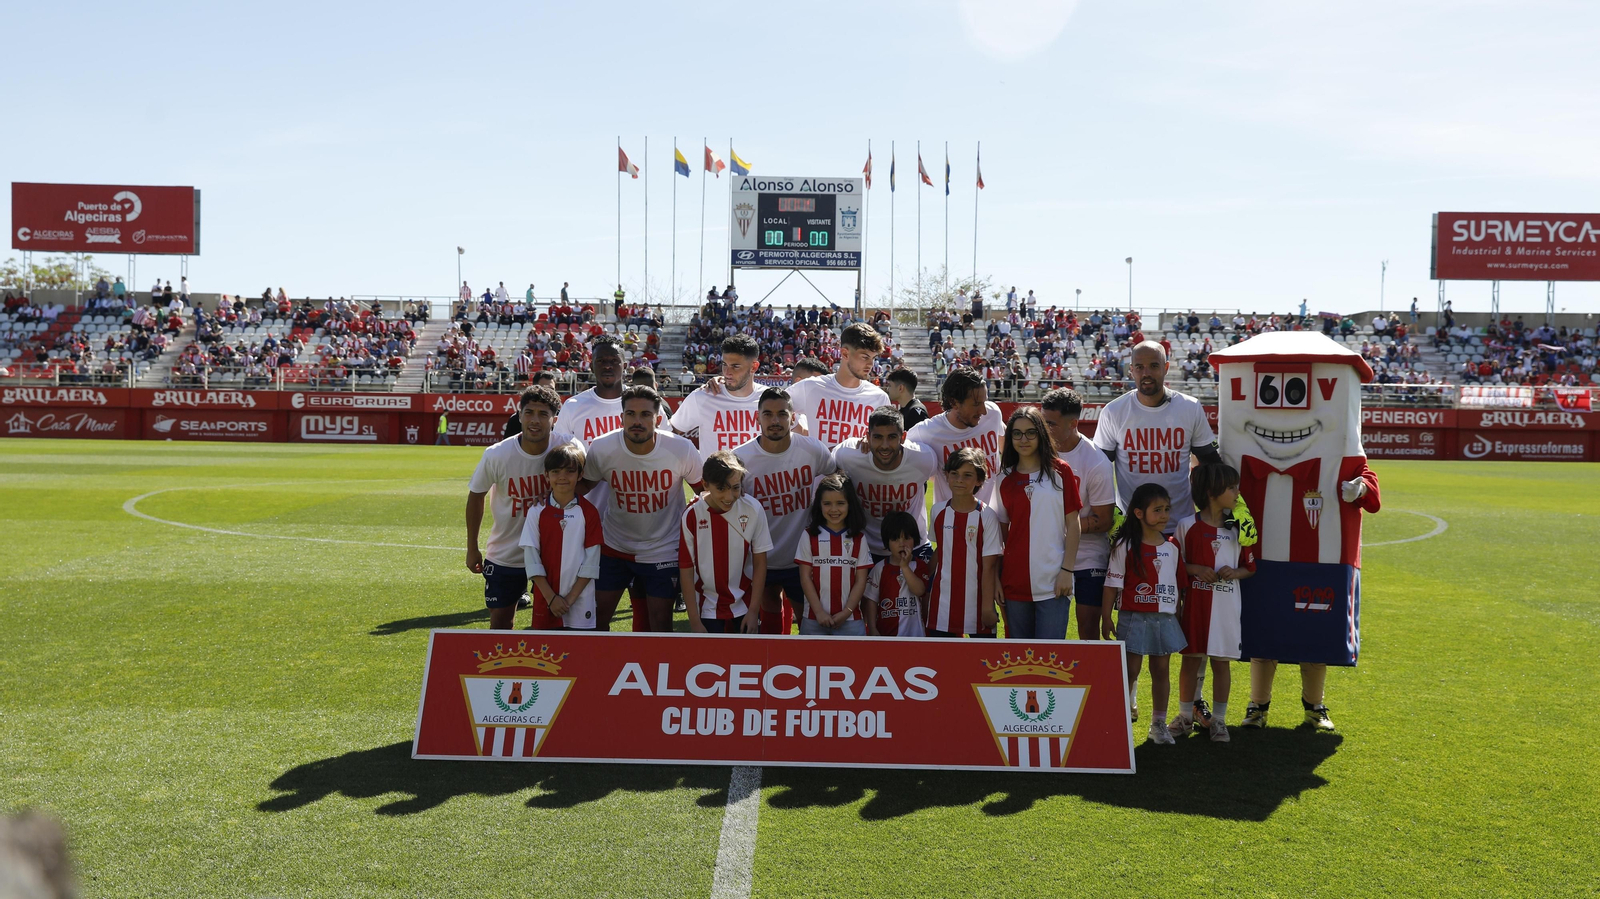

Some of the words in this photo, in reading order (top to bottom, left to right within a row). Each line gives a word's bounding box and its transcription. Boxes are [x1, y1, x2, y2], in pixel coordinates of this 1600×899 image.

[740, 178, 794, 191] Alonso
[799, 179, 854, 193] Alonso
[77, 201, 108, 211] Puerto
[110, 201, 122, 211] de
[64, 210, 122, 224] Algeciras
[33, 230, 74, 238] ALGECIRAS
[85, 227, 121, 235] AESBA
[765, 230, 784, 245] 00
[809, 231, 828, 246] 00
[1452, 246, 1501, 255] Industrial
[1504, 247, 1512, 255] &
[1516, 247, 1551, 256] Marine
[1554, 247, 1597, 257] Services
[1486, 262, 1569, 271] www.surmeyca.com
[310, 396, 410, 406] EUROGRUAS
[432, 396, 493, 412] Adecco
[36, 413, 72, 431] Casa
[66, 412, 118, 431] Mané
[713, 410, 760, 432] ANIM
[1361, 410, 1439, 425] PENERGY
[1123, 426, 1185, 451] ANIMO
[1361, 431, 1410, 444] pulares
[1384, 446, 1435, 456] ALGECIREÑO
[1494, 441, 1584, 456] Expressreformas
[1128, 450, 1181, 474] FERNI
[507, 474, 551, 499] ANIM
[611, 469, 673, 492] ANIMO
[753, 464, 813, 500] ANIMO
[857, 482, 918, 499] ANIMO
[615, 490, 669, 514] FERNI
[757, 487, 812, 517] FERNI
[862, 500, 912, 518] FERNI
[1134, 595, 1176, 604] NUCTECH
[607, 662, 939, 702] ALGECIRAS
[482, 715, 528, 723] ALGECIRAS
[529, 716, 543, 724] C.F.
[661, 707, 735, 736] CLUB
[743, 708, 778, 737] DE
[785, 700, 893, 739] FÚTBOL
[1003, 724, 1049, 733] ALGECIRAS
[1050, 725, 1065, 733] C.F.
